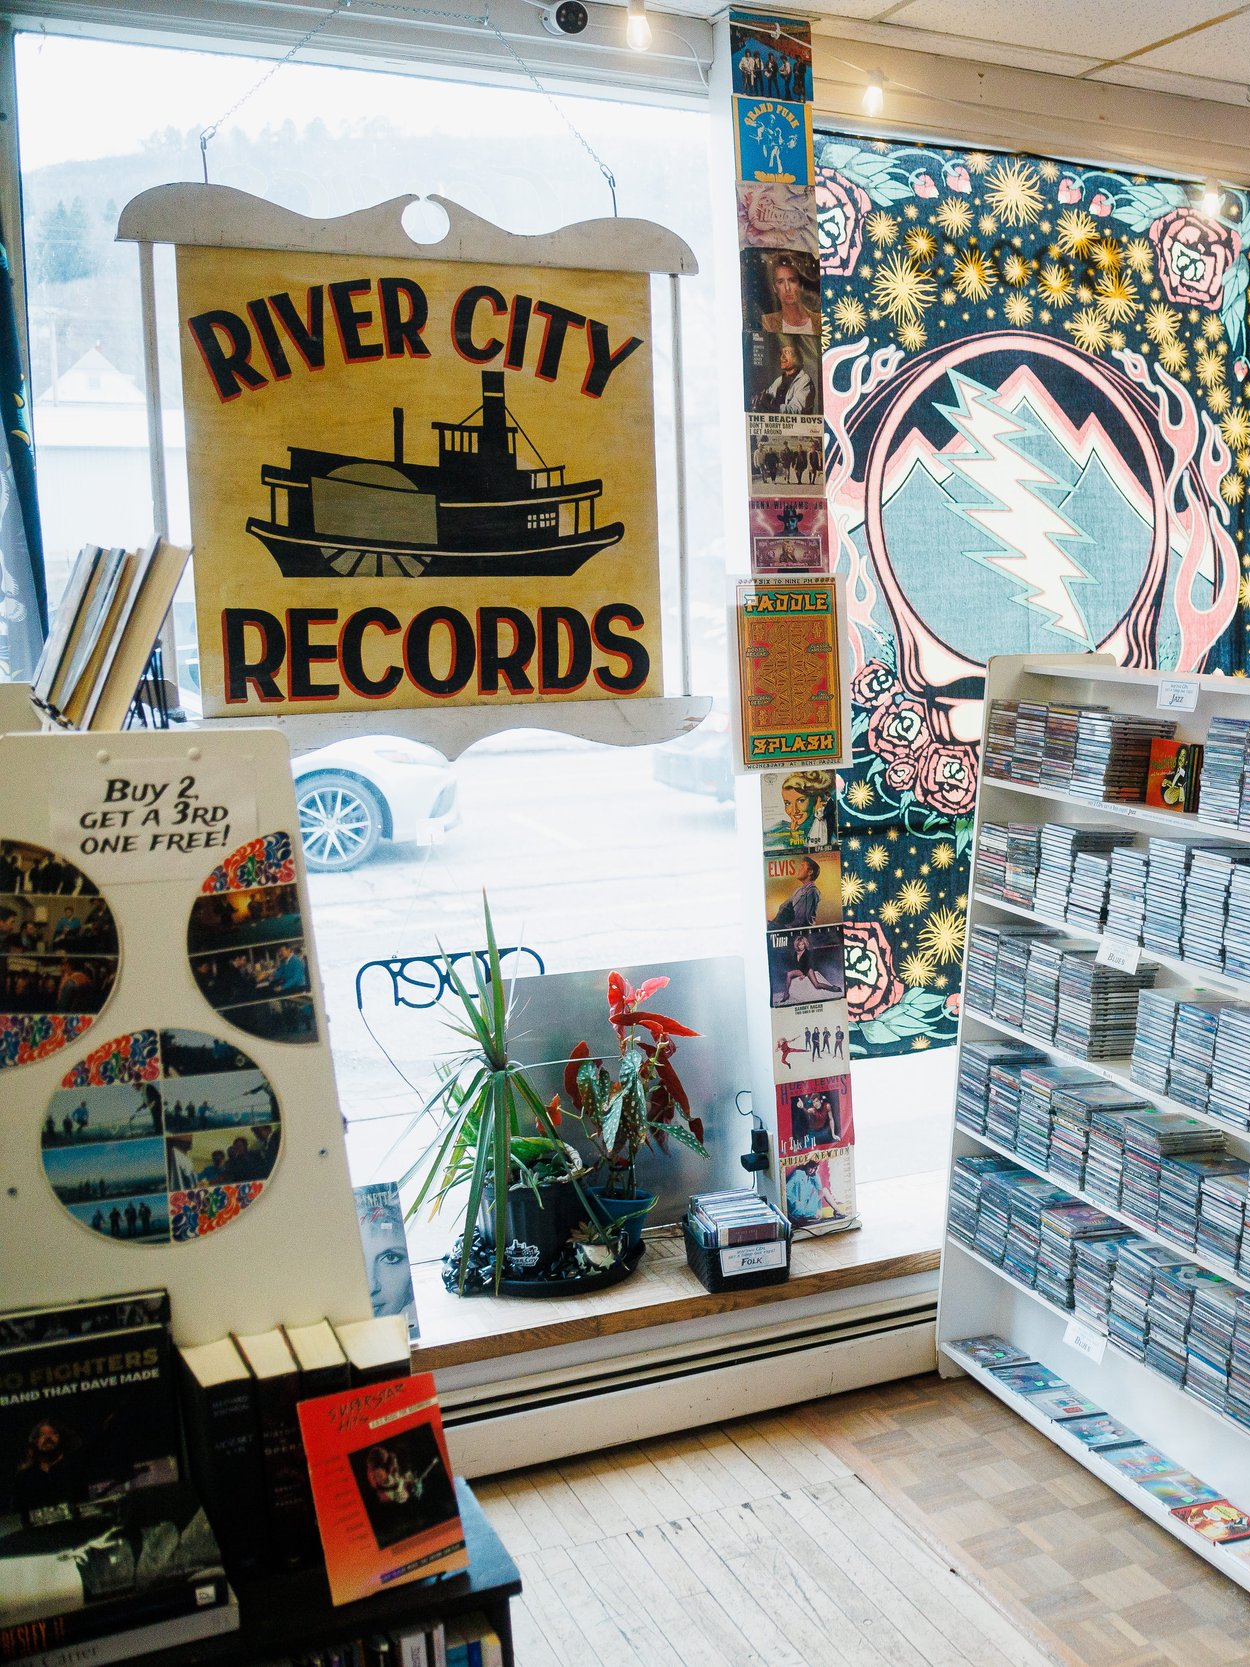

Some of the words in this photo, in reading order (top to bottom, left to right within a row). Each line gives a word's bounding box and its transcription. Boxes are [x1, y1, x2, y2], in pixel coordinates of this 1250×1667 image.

[744, 103, 774, 126] GRAND
[188, 277, 430, 404] RIVER
[451, 285, 644, 399] CITY
[744, 592, 830, 614] PADDLE
[221, 603, 651, 704] RECORDS
[752, 734, 835, 756] SPLASH
[79, 809, 131, 830] GET
[141, 807, 161, 826] A
[172, 801, 230, 828] 3RD
[80, 834, 141, 856] ONE
[150, 825, 232, 854] FREE!
[768, 859, 795, 878] ELVIS
[770, 933, 788, 948] Tina
[780, 1078, 811, 1105] HUEY
[813, 1074, 847, 1095] LEWIS
[782, 1154, 810, 1166] JUICE
[815, 1147, 850, 1161] NEWTON
[741, 1256, 763, 1266] FOLK
[30, 1348, 160, 1385] FIGHTERS
[43, 1382, 78, 1399] THAT
[81, 1375, 118, 1391] DAVE
[120, 1367, 160, 1384] MADE
